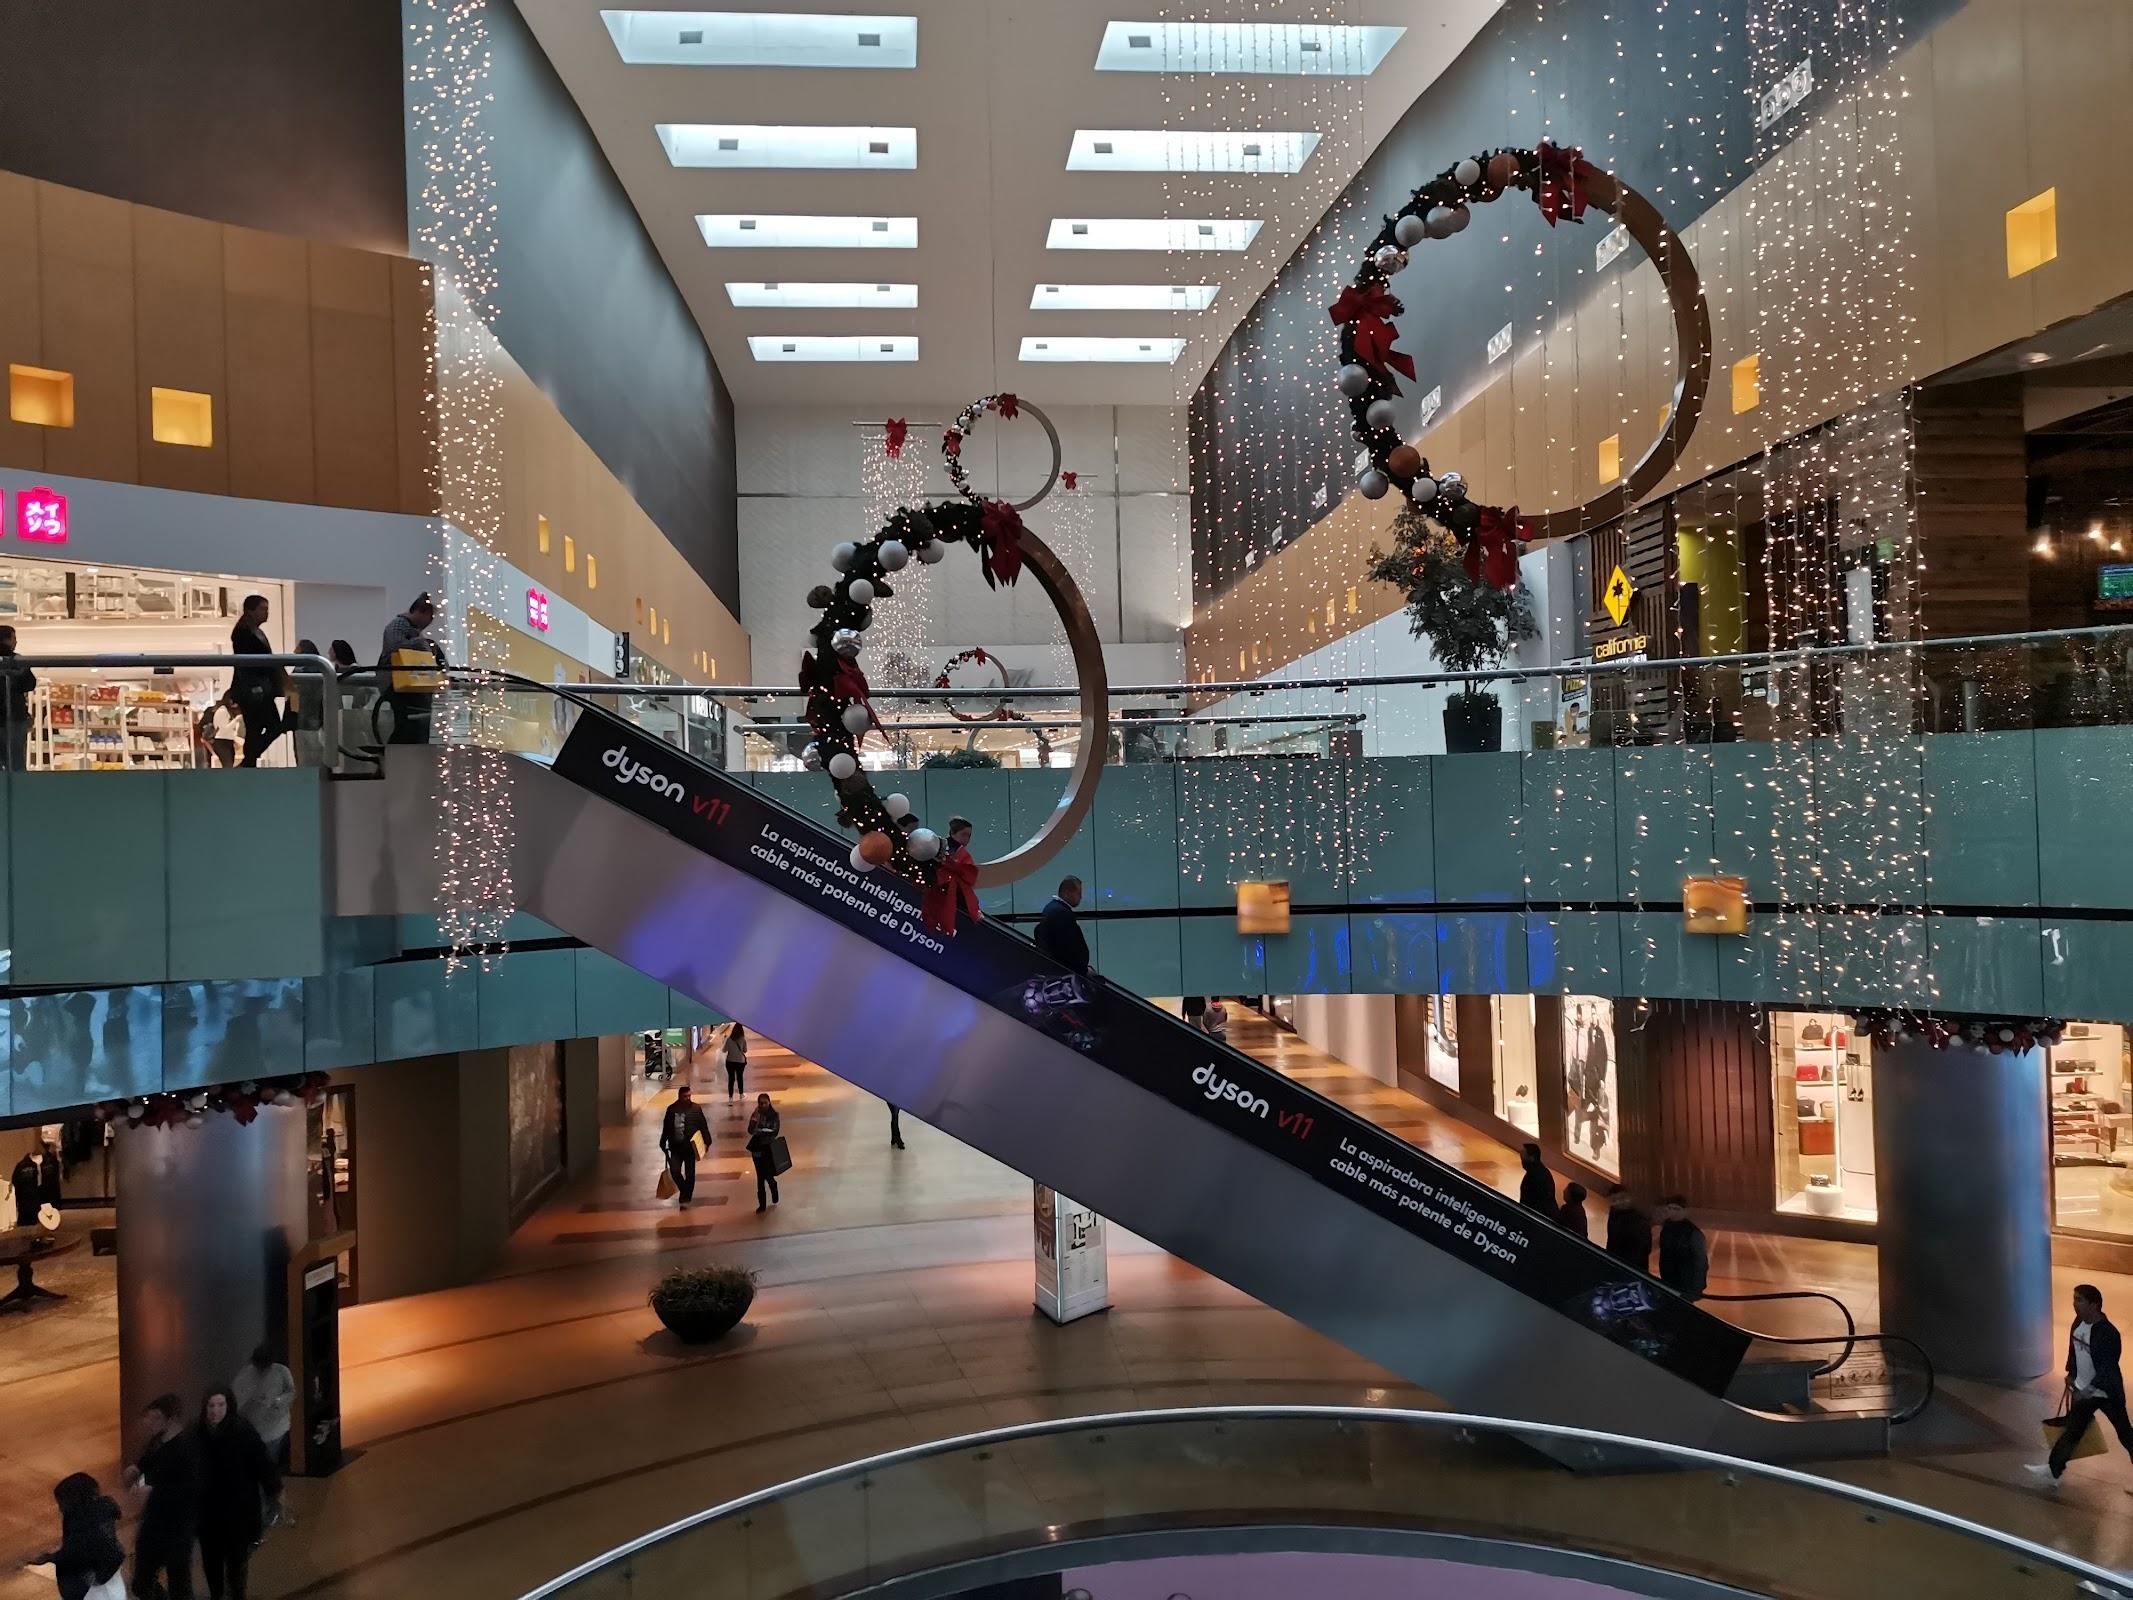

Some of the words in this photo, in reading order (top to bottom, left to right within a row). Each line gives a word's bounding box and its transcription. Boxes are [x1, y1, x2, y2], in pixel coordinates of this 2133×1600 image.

[1595, 635, 1647, 659] california
[601, 745, 685, 803] dyson
[692, 794, 732, 826] v11
[750, 843, 790, 872] cable
[790, 866, 822, 888] más
[821, 882, 878, 918] potente
[879, 911, 899, 929] de
[899, 920, 945, 955] Dyson
[760, 823, 779, 843] La
[780, 836, 859, 885] aspiradora
[860, 876, 928, 923] inteligen
[1191, 1062, 1270, 1119] dyson
[1277, 1107, 1315, 1140] v11
[1329, 1156, 1368, 1183] cable
[1368, 1177, 1398, 1199] más
[1397, 1193, 1453, 1229] potente
[1453, 1222, 1473, 1240] de
[1473, 1229, 1518, 1264] Dyson
[1339, 1136, 1358, 1154] La
[1358, 1148, 1433, 1197] aspiradora
[1434, 1186, 1507, 1236] inteligente
[1507, 1228, 1529, 1249] sin
